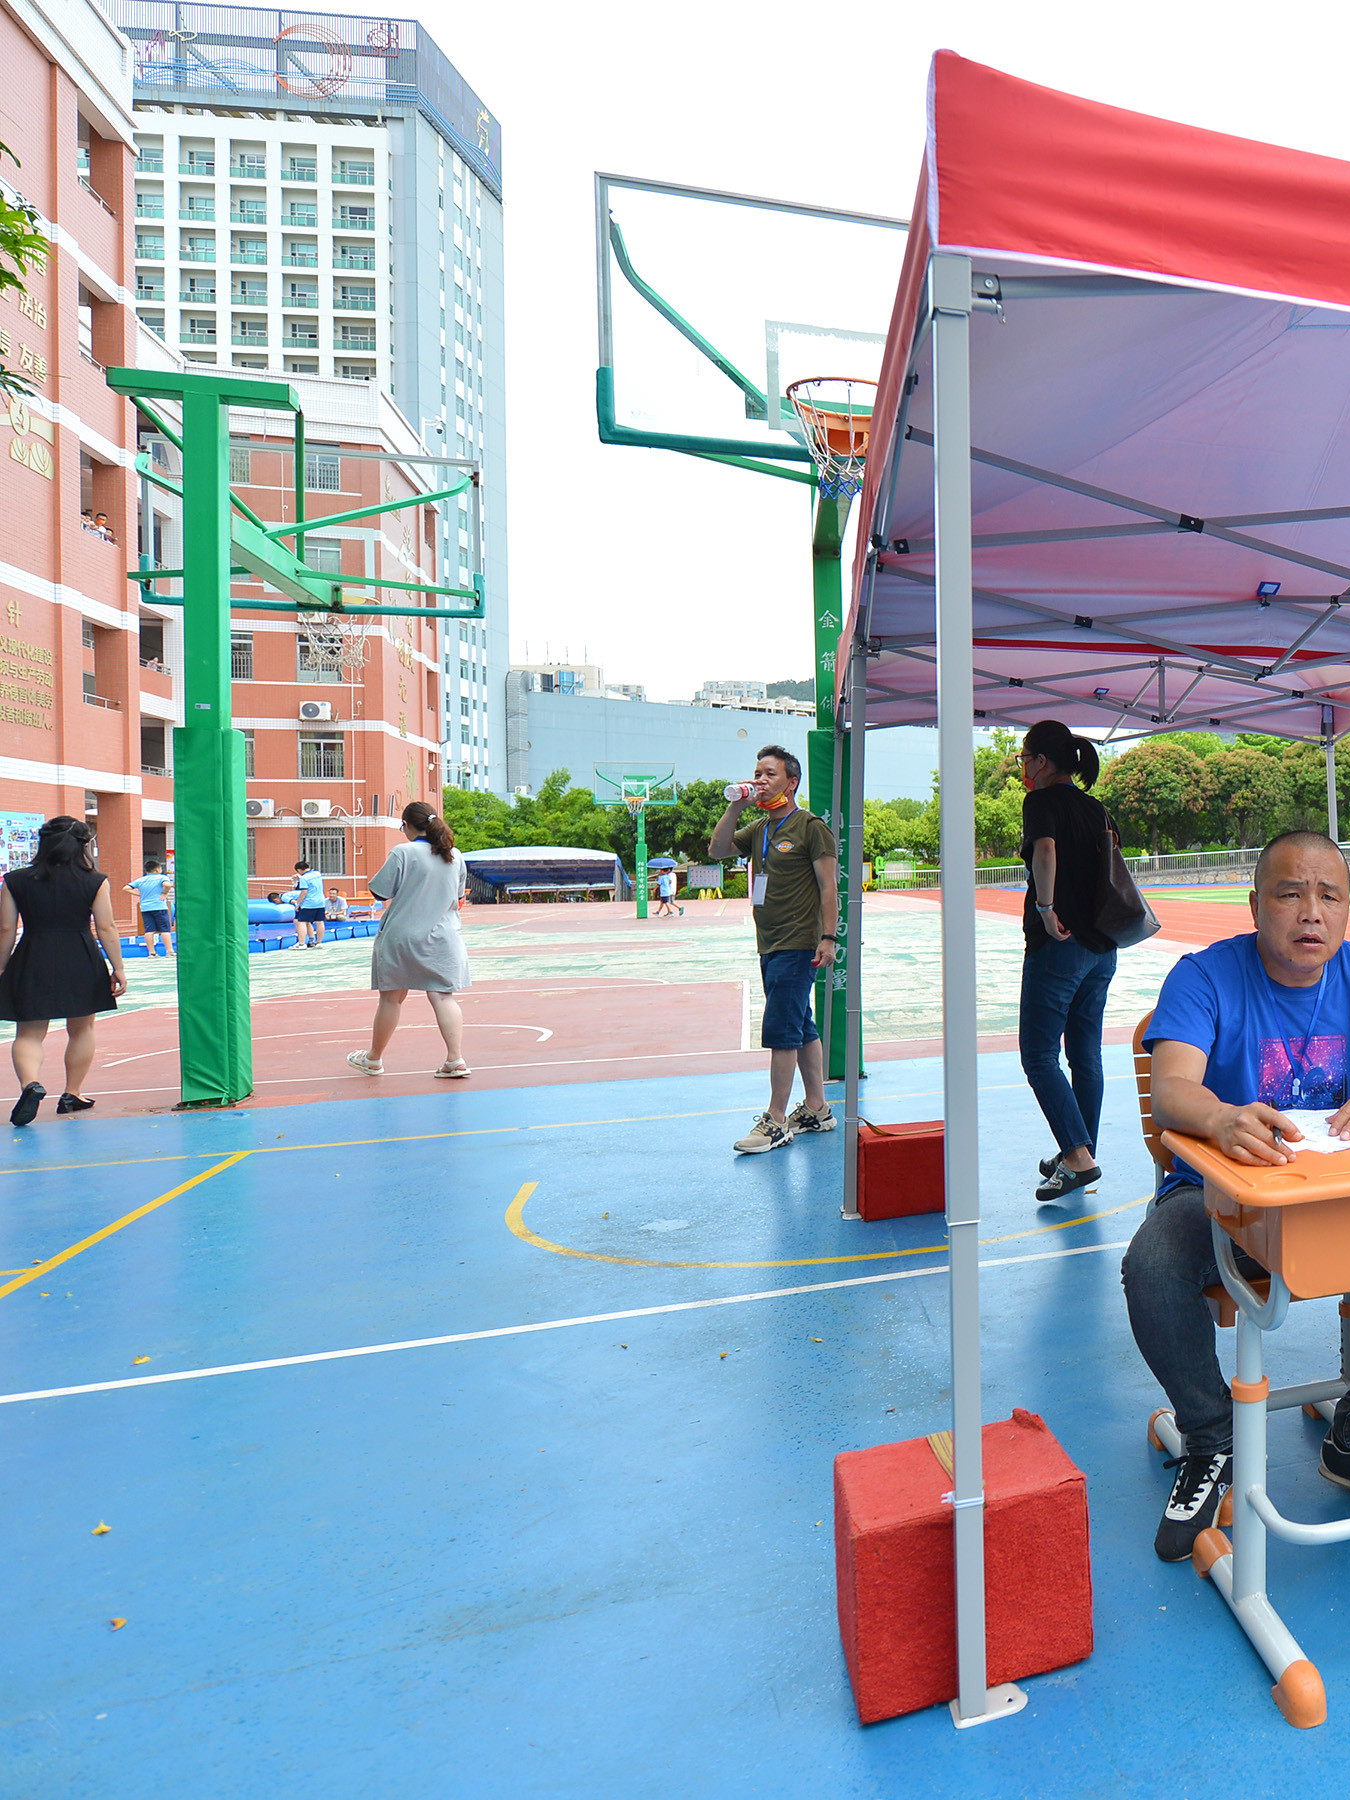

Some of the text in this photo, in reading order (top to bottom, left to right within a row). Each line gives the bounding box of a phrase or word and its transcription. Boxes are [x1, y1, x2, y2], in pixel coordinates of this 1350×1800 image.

[19, 291, 47, 330] 法治
[19, 342, 47, 383] 友善
[7, 600, 22, 628] 针
